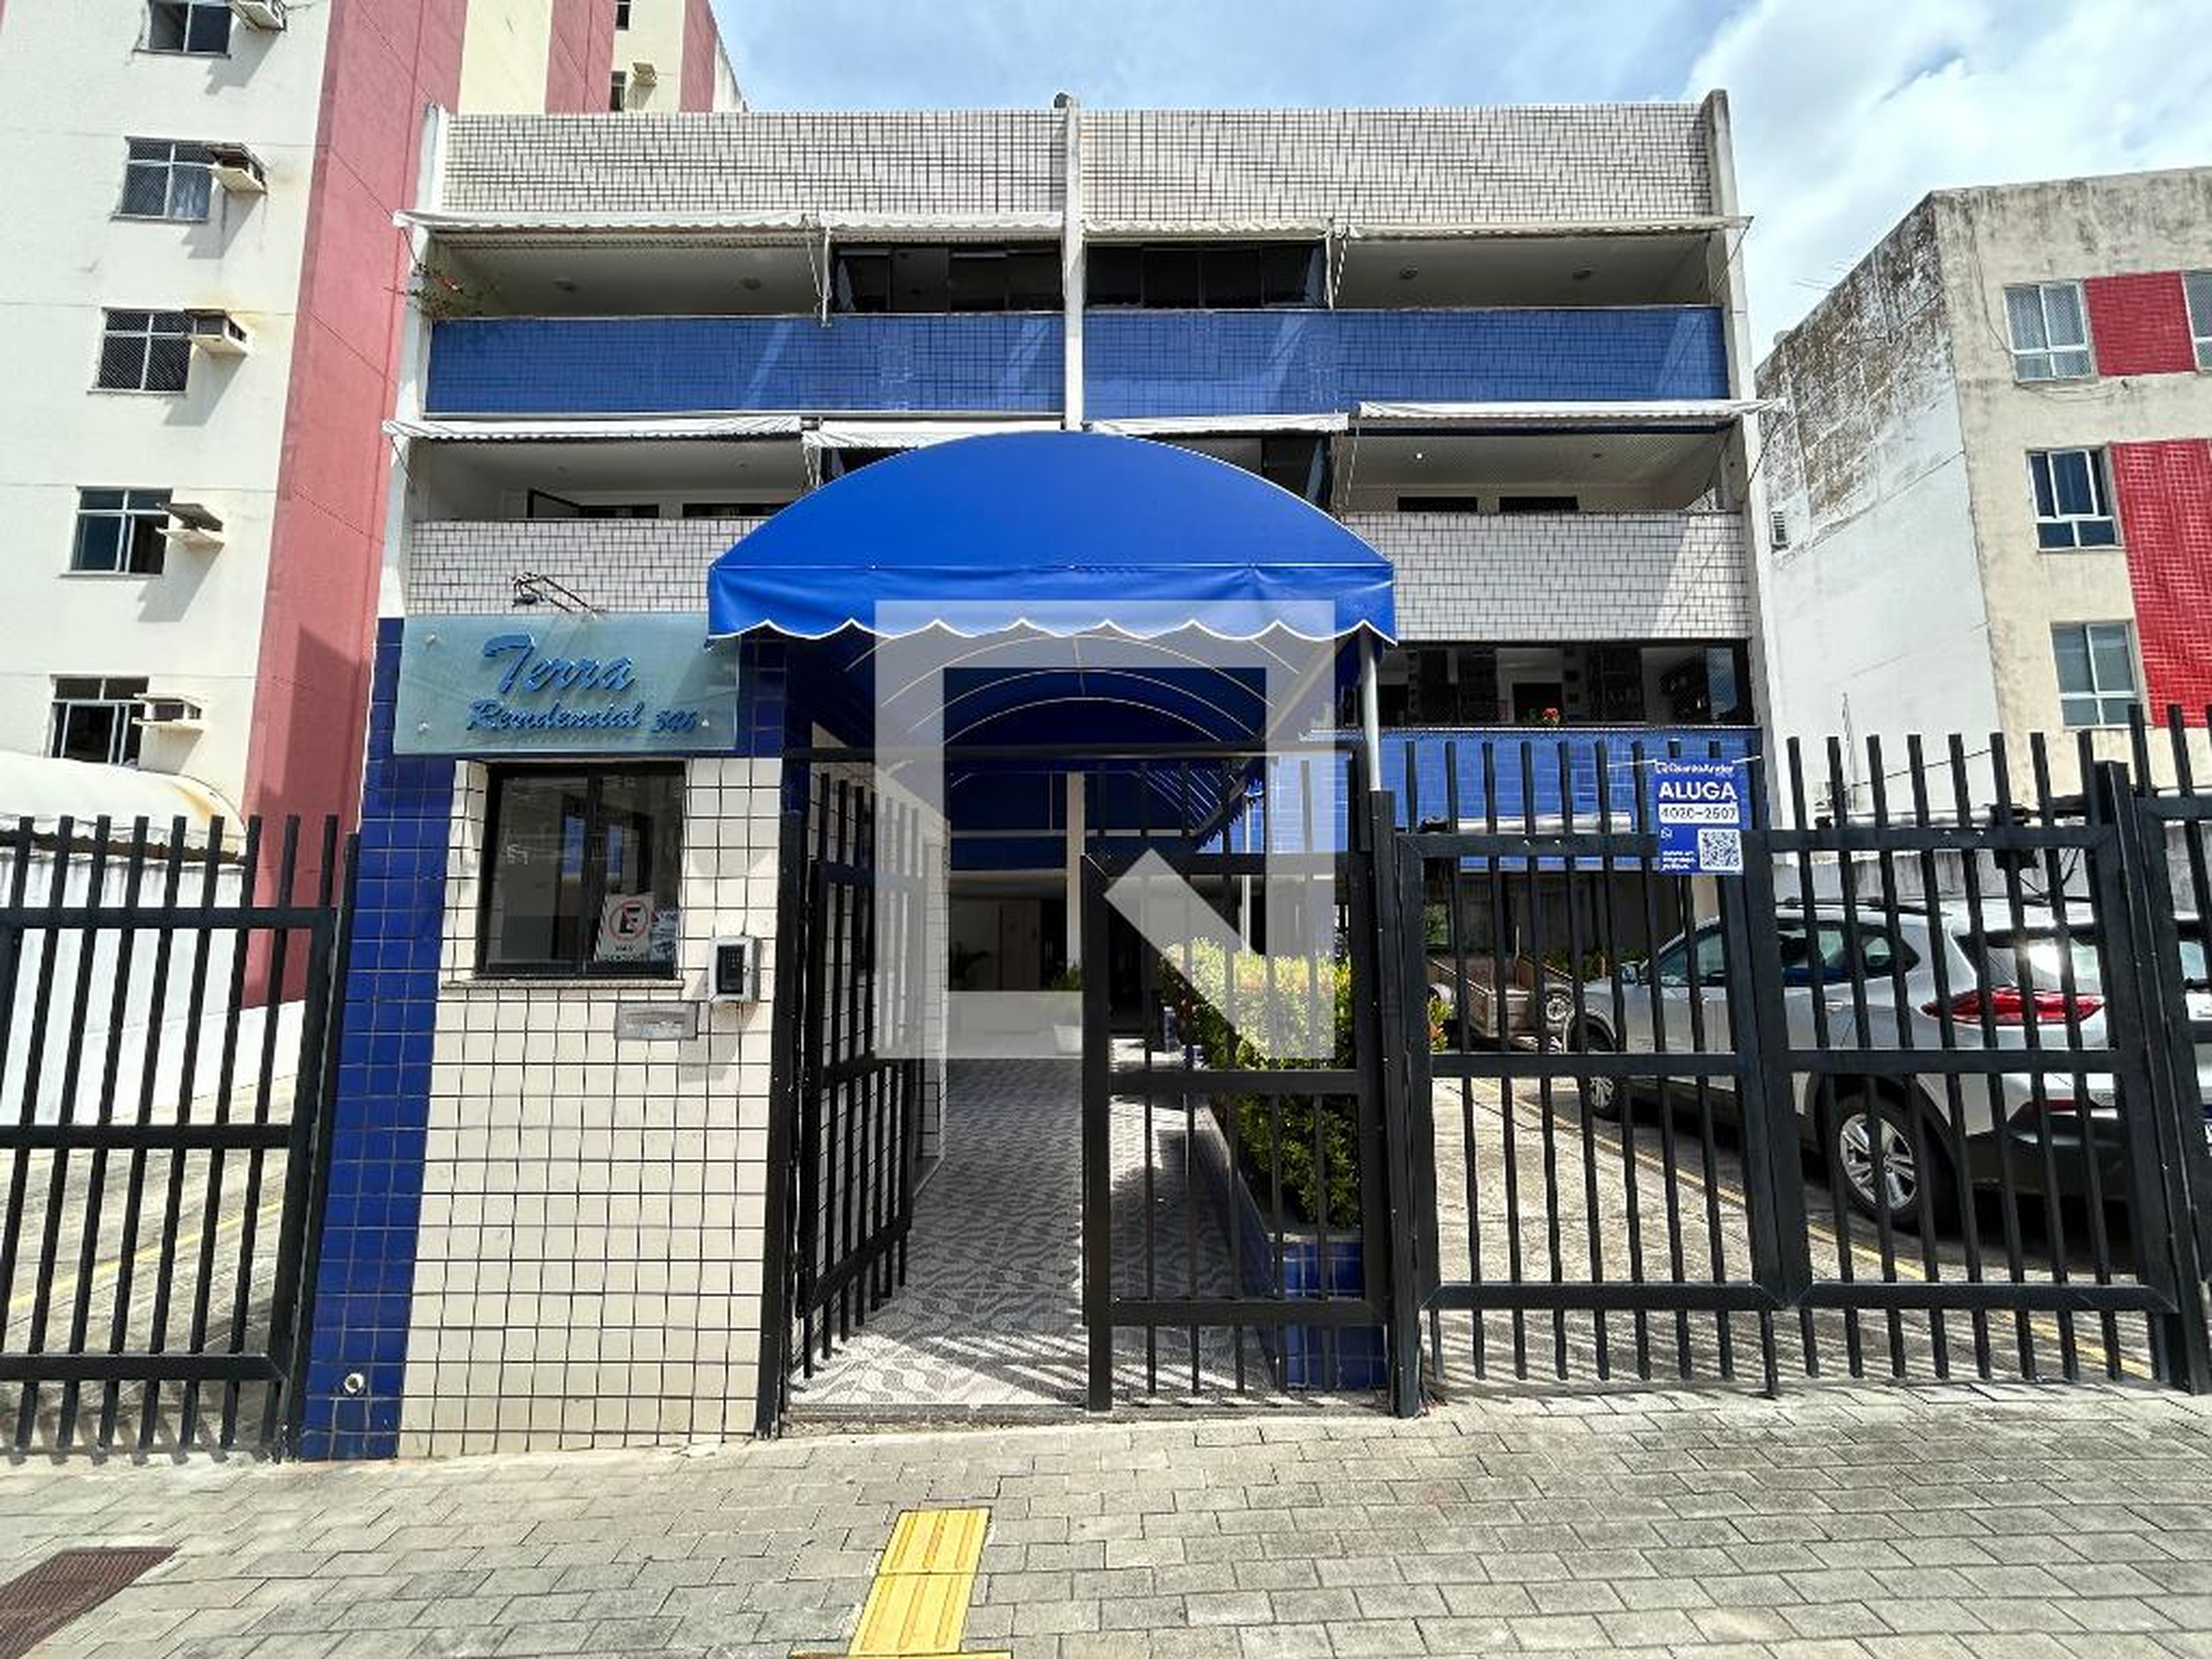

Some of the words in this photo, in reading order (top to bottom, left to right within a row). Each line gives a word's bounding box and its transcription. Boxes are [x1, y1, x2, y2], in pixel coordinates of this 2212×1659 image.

[482, 632, 636, 695] Terra
[1658, 781, 1738, 800] ALUGA
[1661, 806, 1735, 820] 4020-2507
